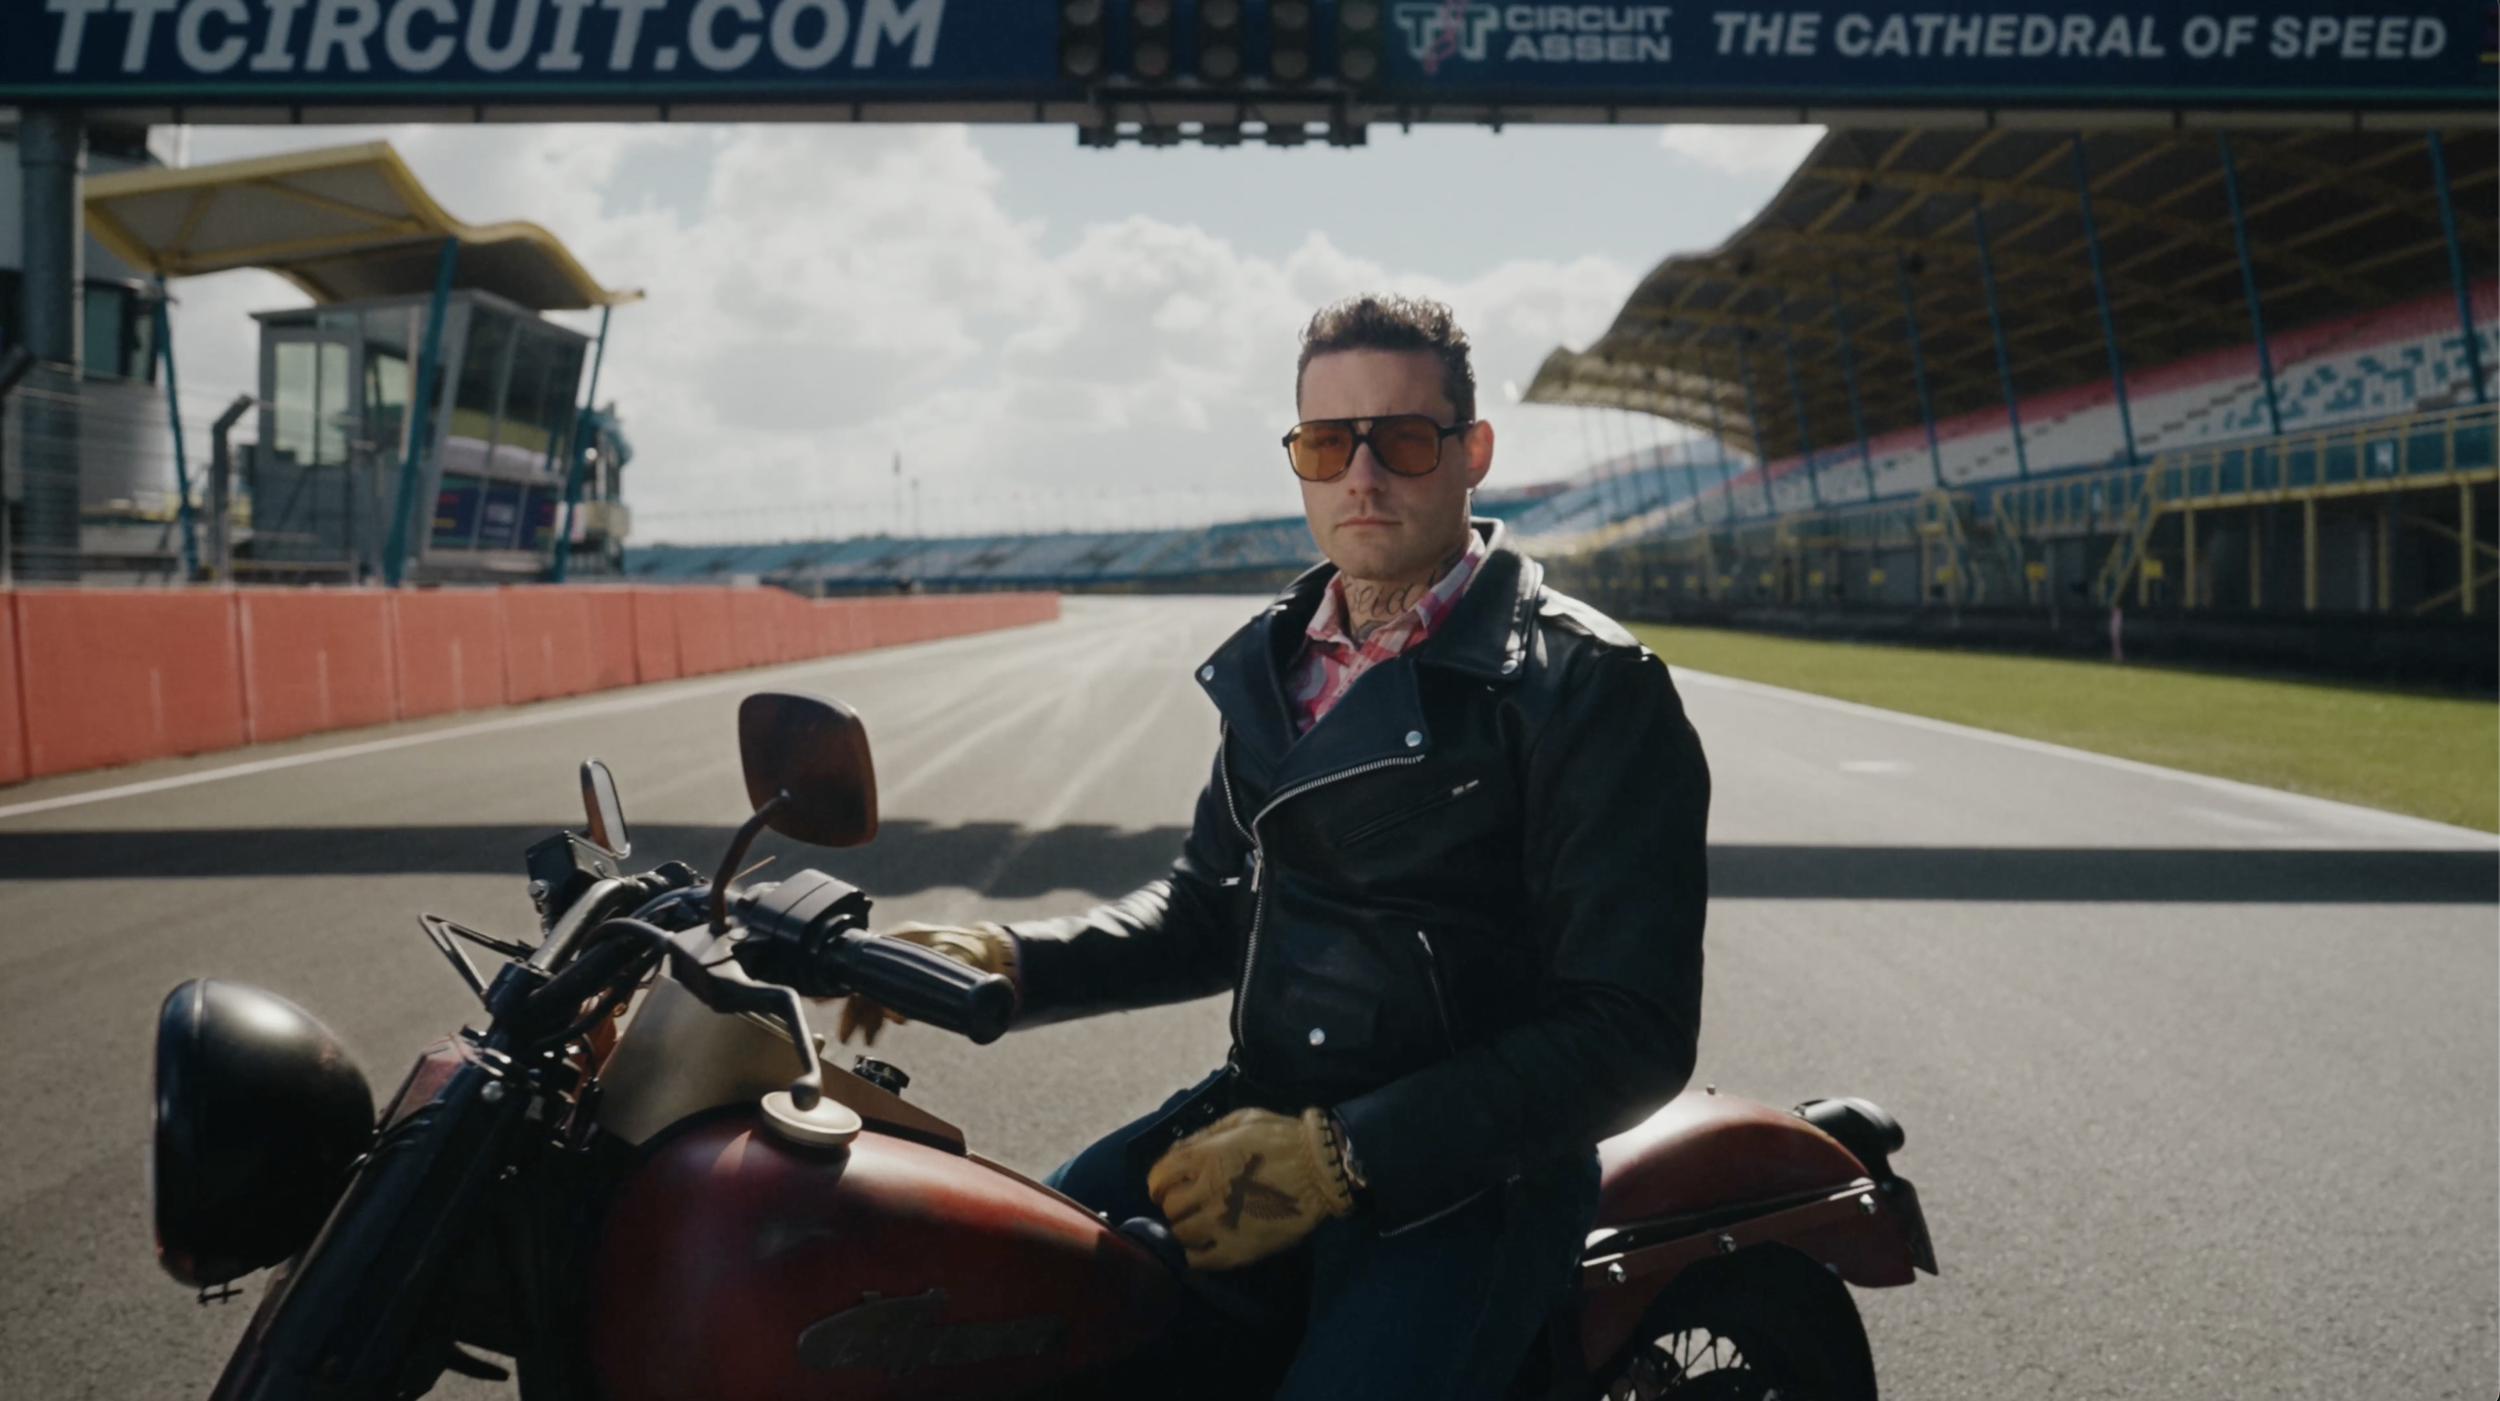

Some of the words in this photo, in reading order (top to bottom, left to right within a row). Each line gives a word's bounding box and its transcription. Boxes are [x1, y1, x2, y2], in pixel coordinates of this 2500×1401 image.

[46, 0, 946, 73] TTCIRCUIT.COM
[1504, 5, 1673, 32] CIRCUIT
[1712, 11, 1822, 56] THE
[1833, 13, 2166, 58] CATHEDRAL
[2181, 15, 2258, 58] OF
[2269, 15, 2448, 59] SPEED
[1505, 34, 1672, 62] ASSEN
